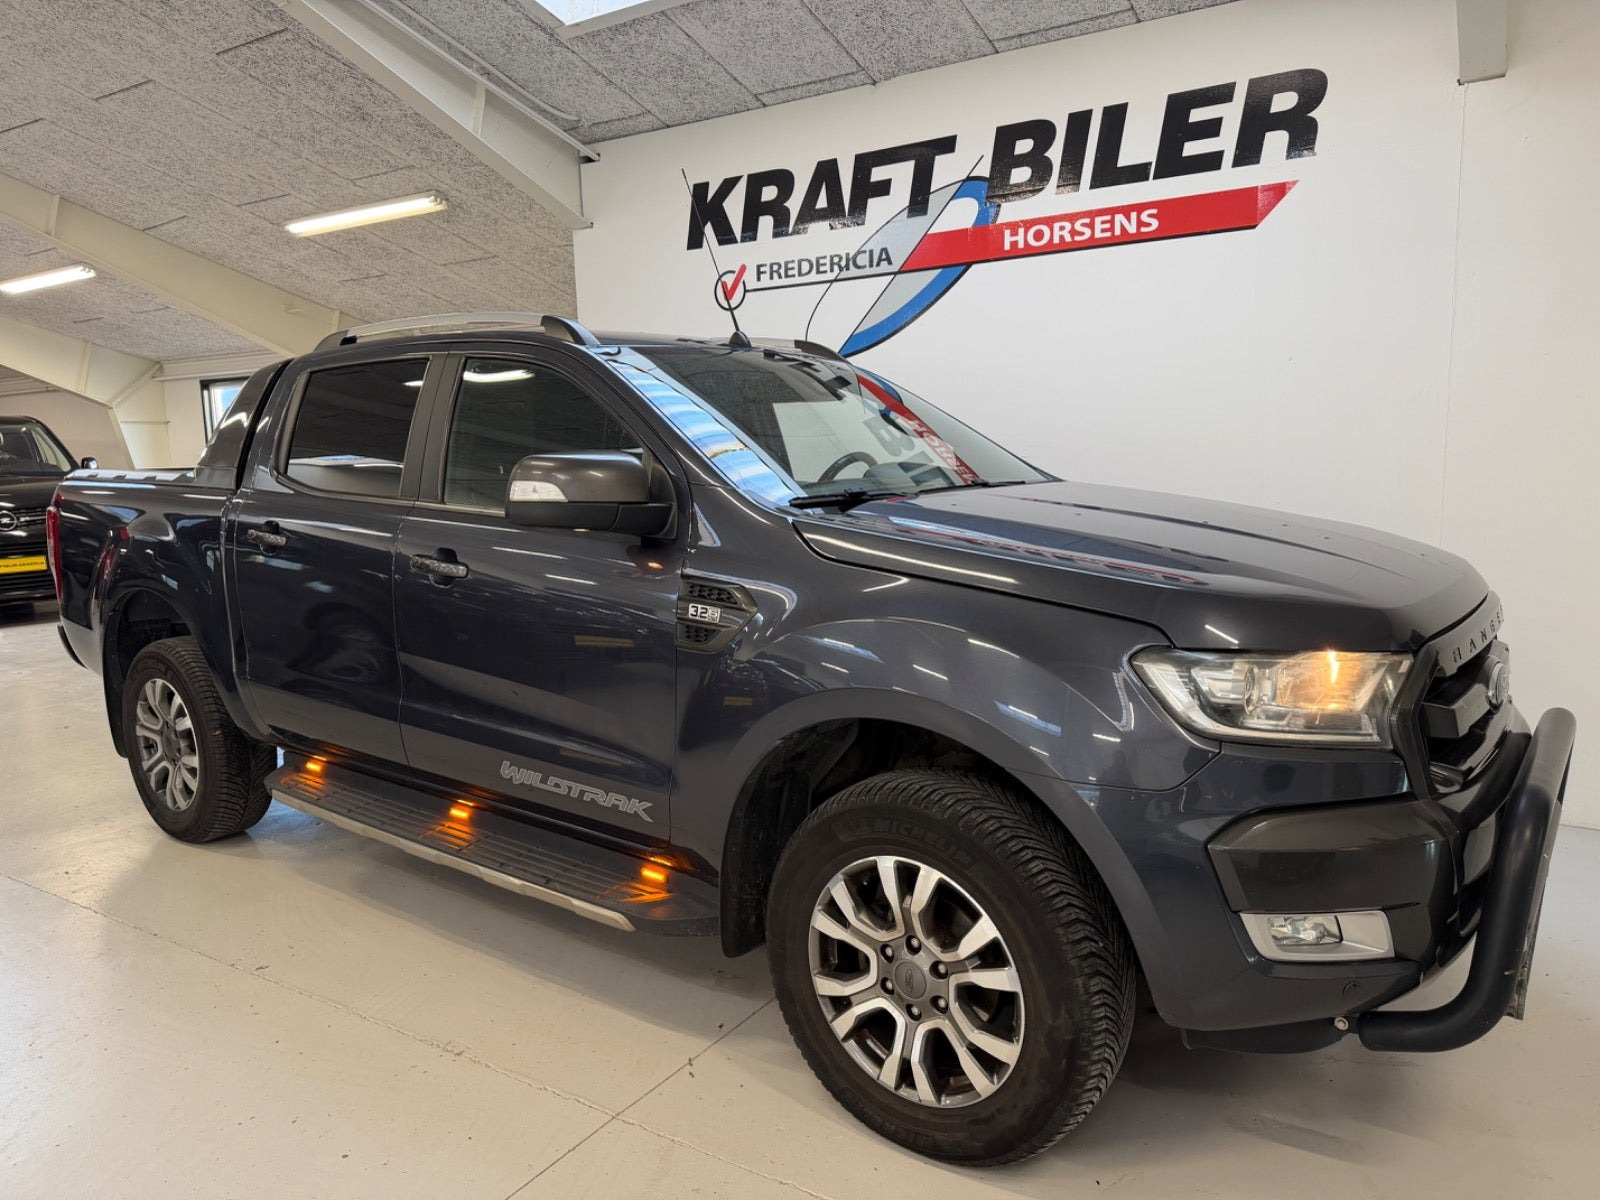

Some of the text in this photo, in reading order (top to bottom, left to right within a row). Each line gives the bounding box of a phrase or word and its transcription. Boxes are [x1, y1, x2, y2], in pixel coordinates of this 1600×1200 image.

[686, 68, 1328, 250] KRAFT BILER
[1002, 208, 1160, 251] HORSENS
[755, 246, 894, 282] FREDERICIA
[500, 760, 654, 823] WILDTRAK
